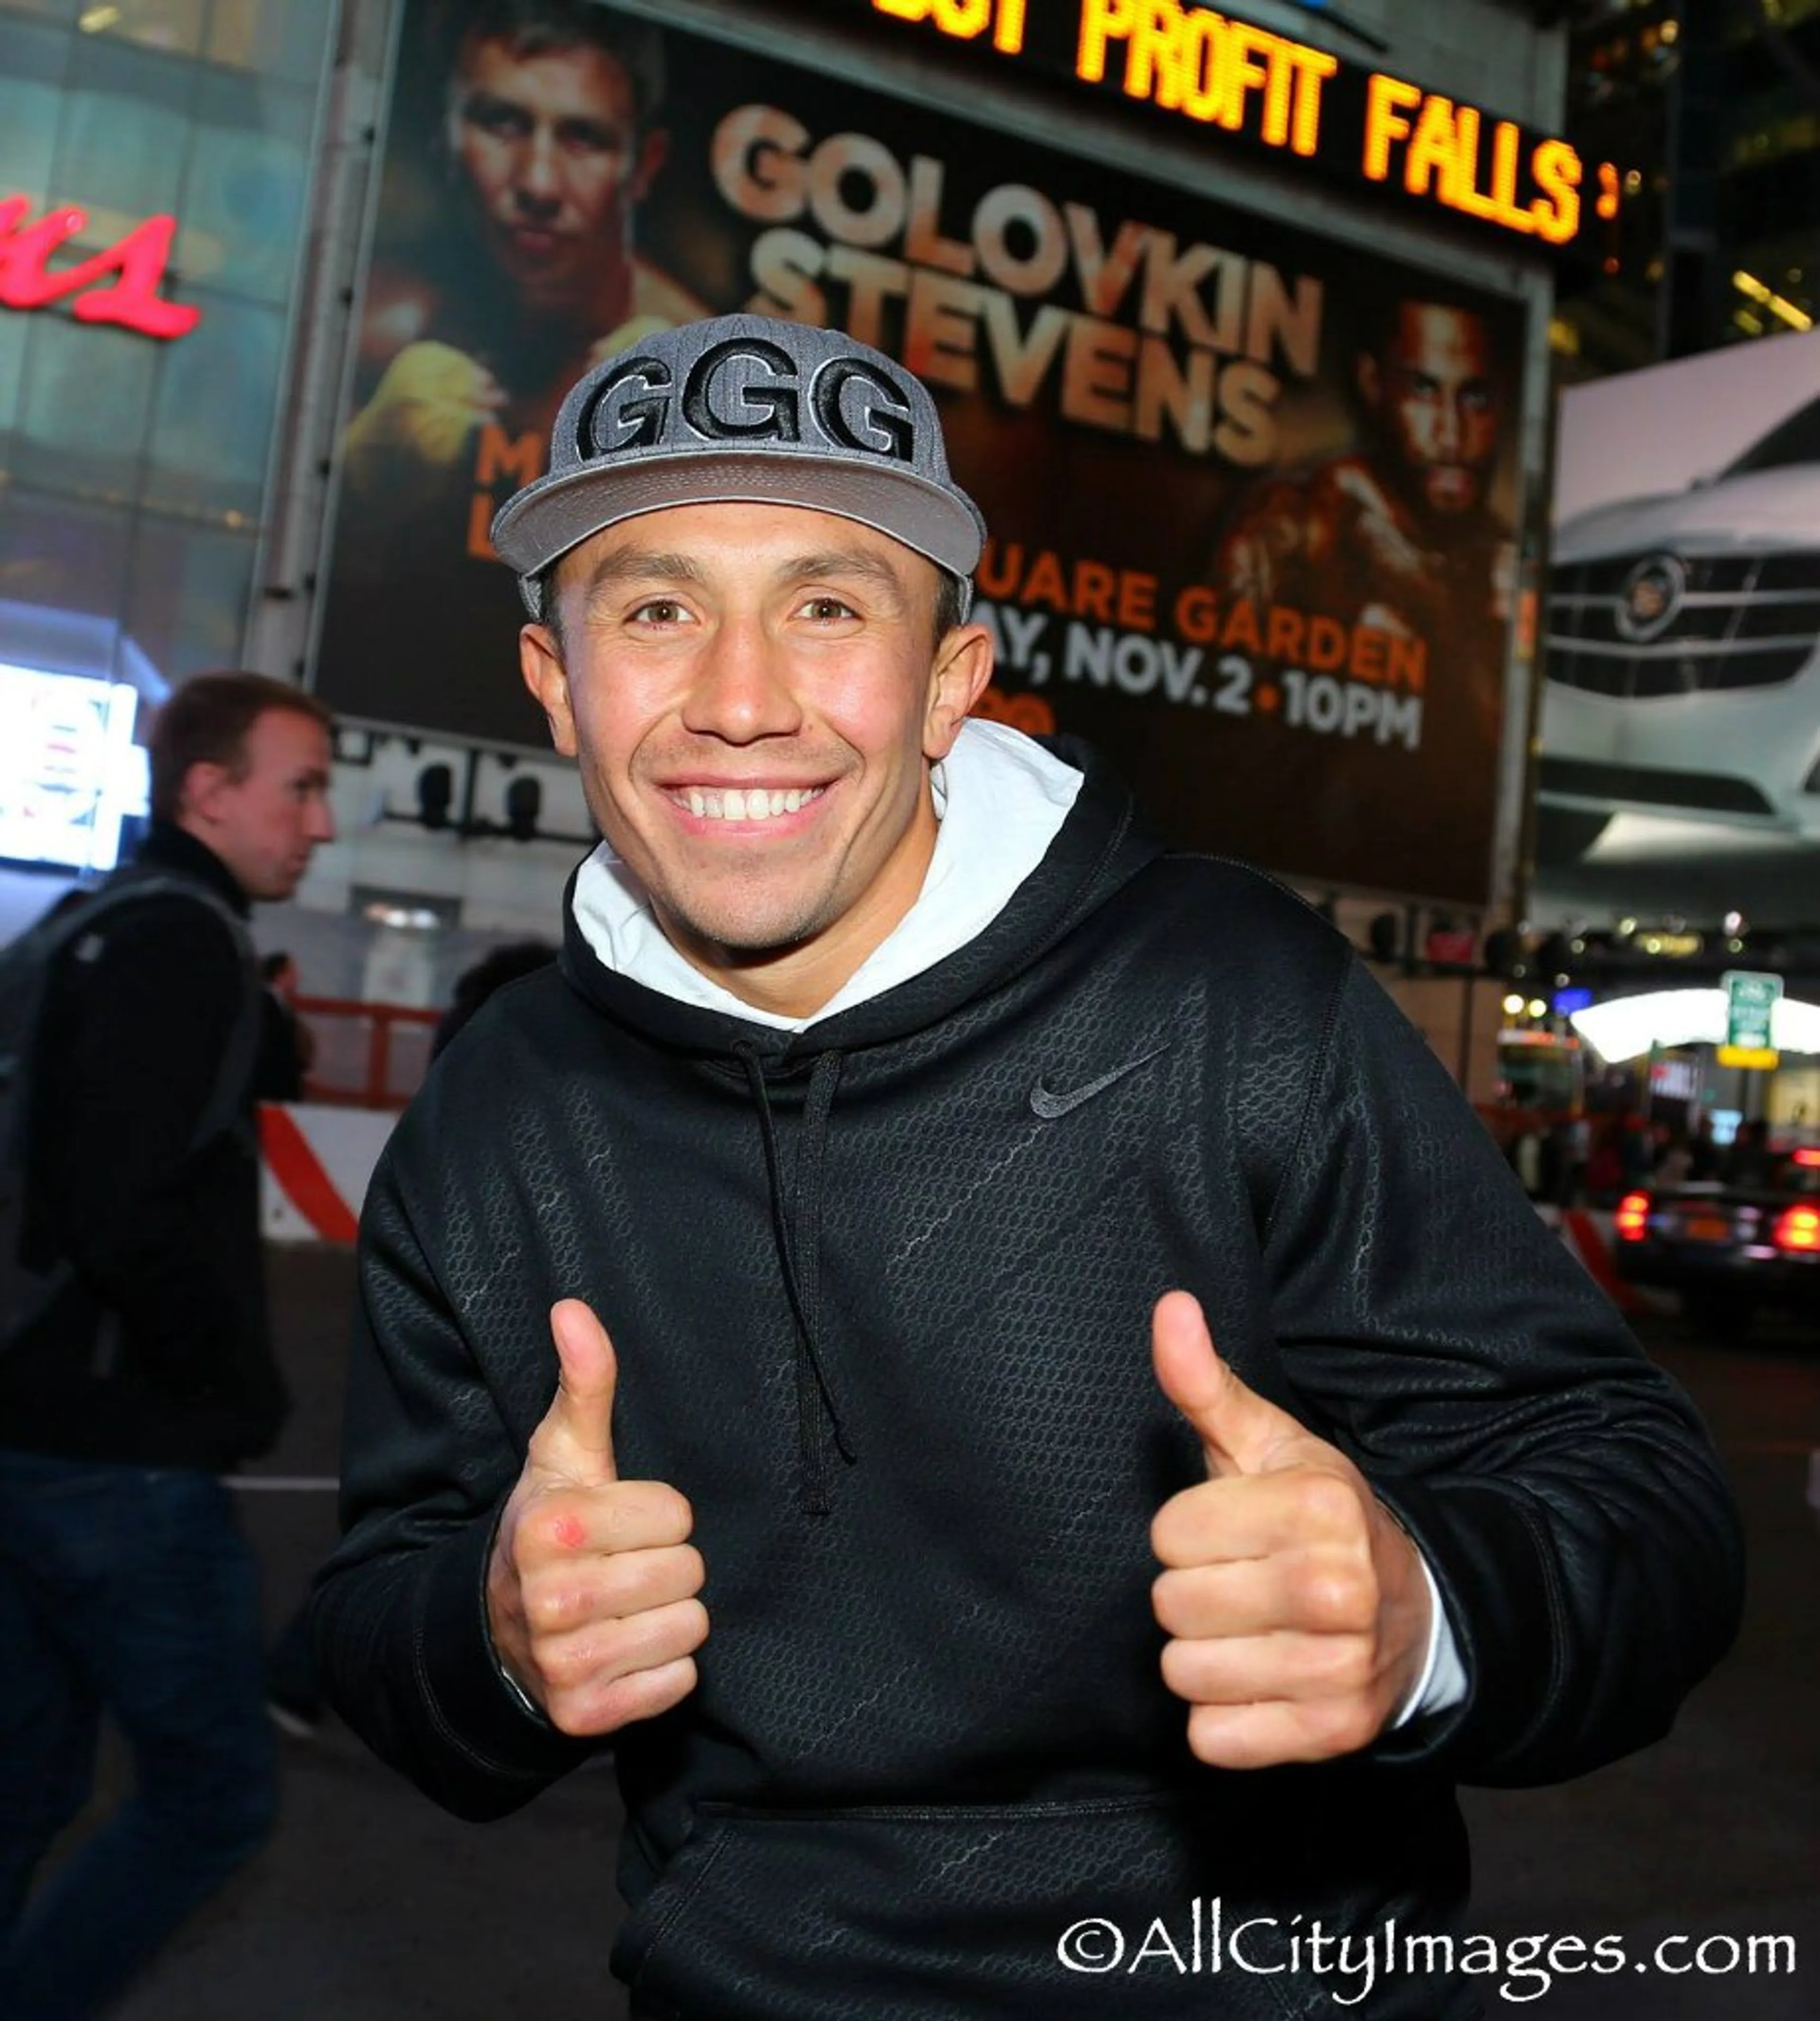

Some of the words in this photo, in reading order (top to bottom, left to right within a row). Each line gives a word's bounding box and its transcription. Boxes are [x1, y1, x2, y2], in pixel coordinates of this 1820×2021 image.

[1075, 0, 1338, 156] PROFIT
[1362, 73, 1583, 245] FALLS
[711, 103, 1324, 378] GOLOVKIN
[575, 335, 915, 463] GGG
[745, 227, 1280, 467] STEVENS
[1064, 621, 1209, 706] NOV.
[1214, 656, 1253, 715] 2
[1283, 670, 1422, 752] 10PM
[1175, 586, 1427, 692] GARDEN
